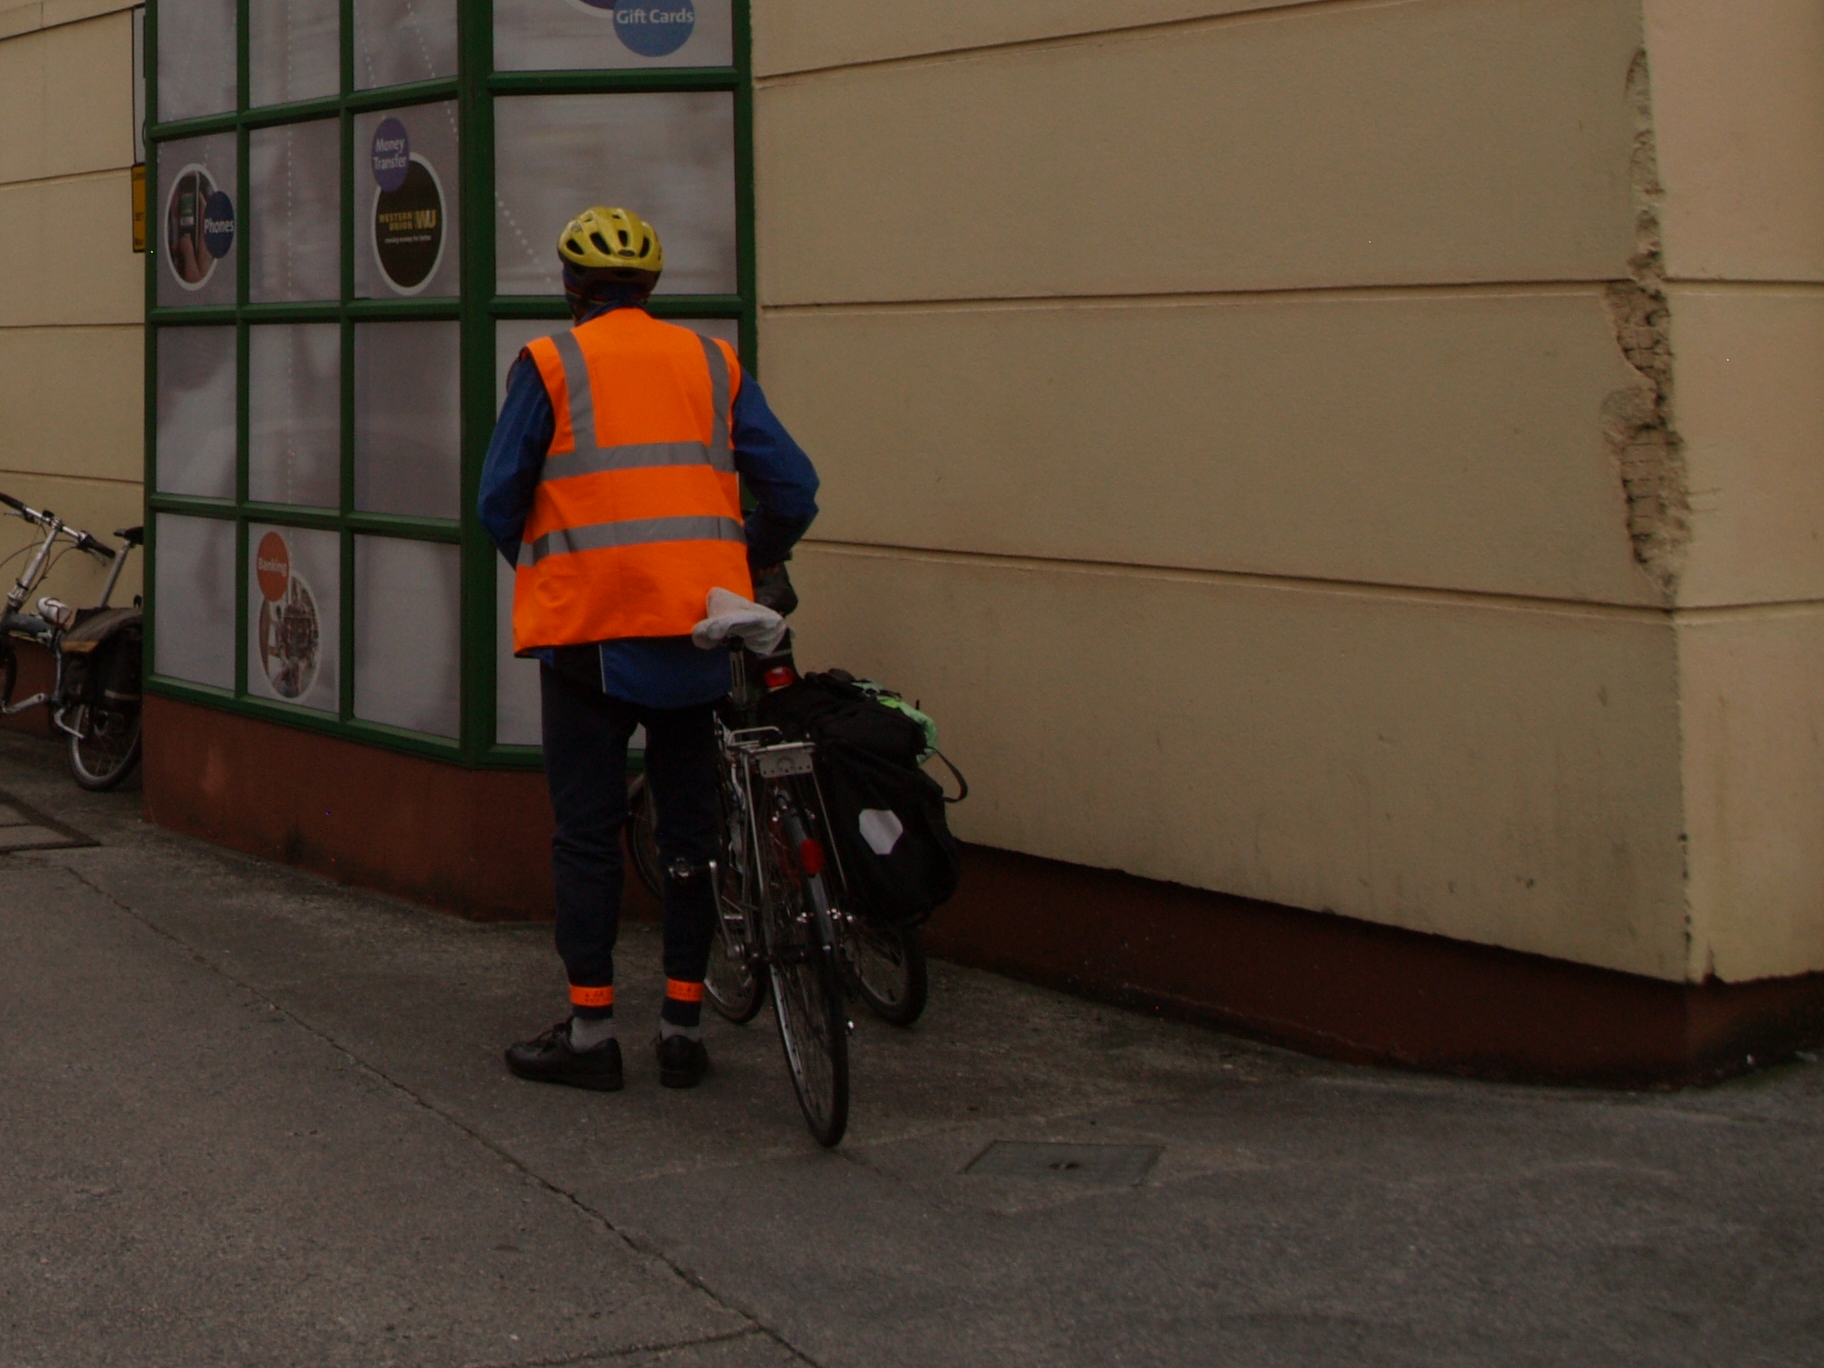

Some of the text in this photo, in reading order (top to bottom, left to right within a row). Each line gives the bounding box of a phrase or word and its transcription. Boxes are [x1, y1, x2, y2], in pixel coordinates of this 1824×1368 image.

[616, 8, 695, 24] Gift Cards
[375, 138, 406, 155] Money
[373, 154, 408, 171] Transfer
[204, 218, 235, 234] Phones
[257, 557, 288, 577] Banking
